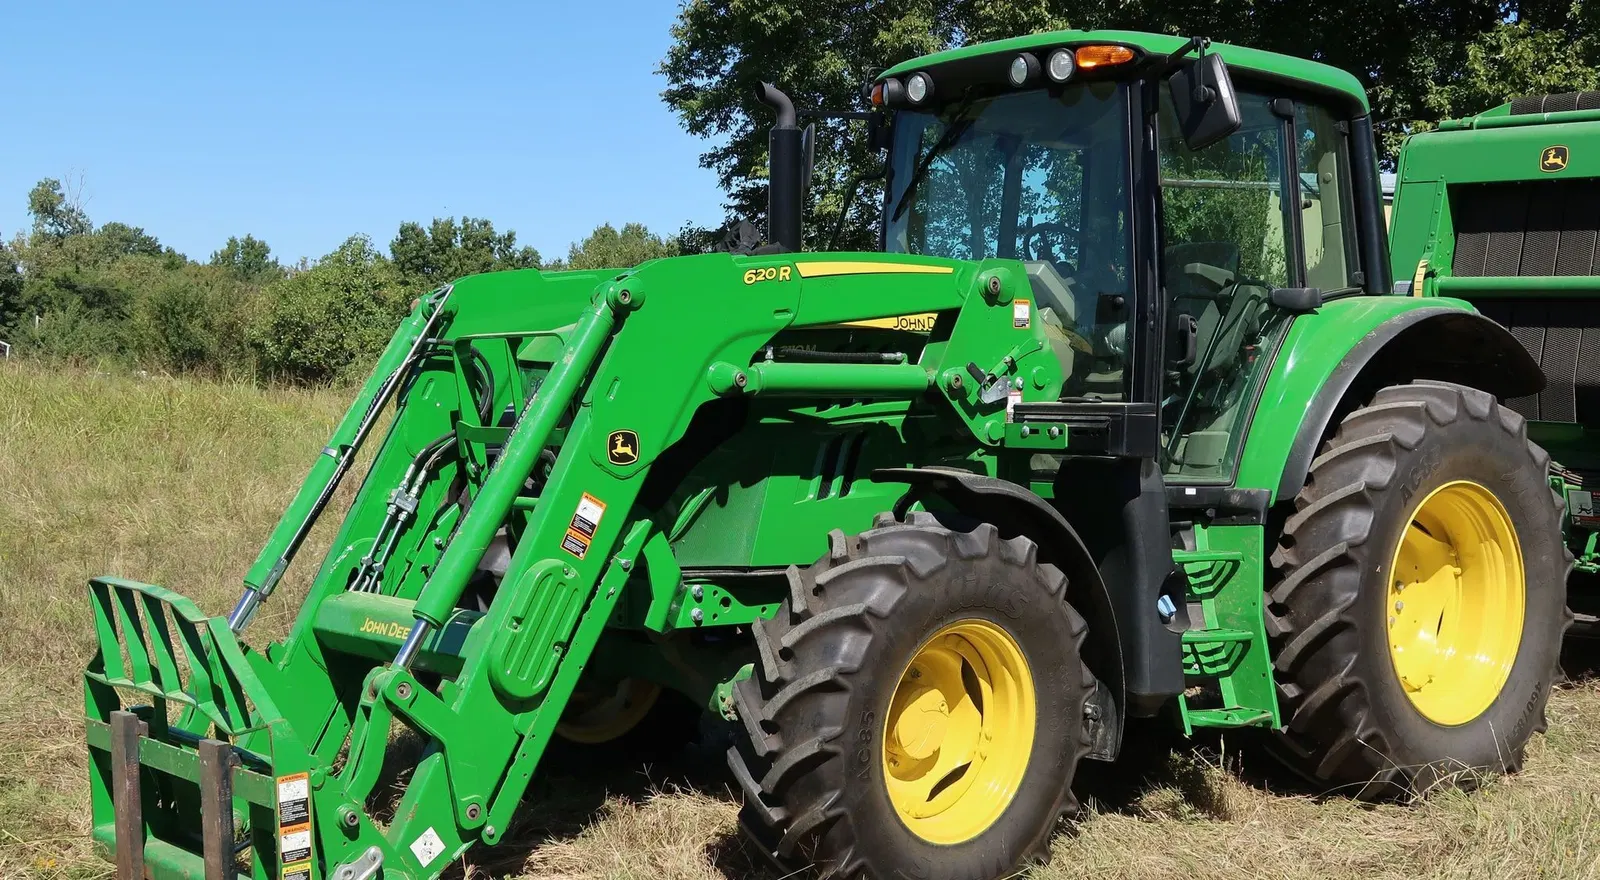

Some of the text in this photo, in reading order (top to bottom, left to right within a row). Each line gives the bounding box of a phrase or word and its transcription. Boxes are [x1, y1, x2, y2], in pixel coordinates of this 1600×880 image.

[743, 267, 777, 285] 620
[893, 316, 926, 329] JOHN
[360, 617, 412, 640] JOHN DEE
[856, 710, 875, 782] AC85
